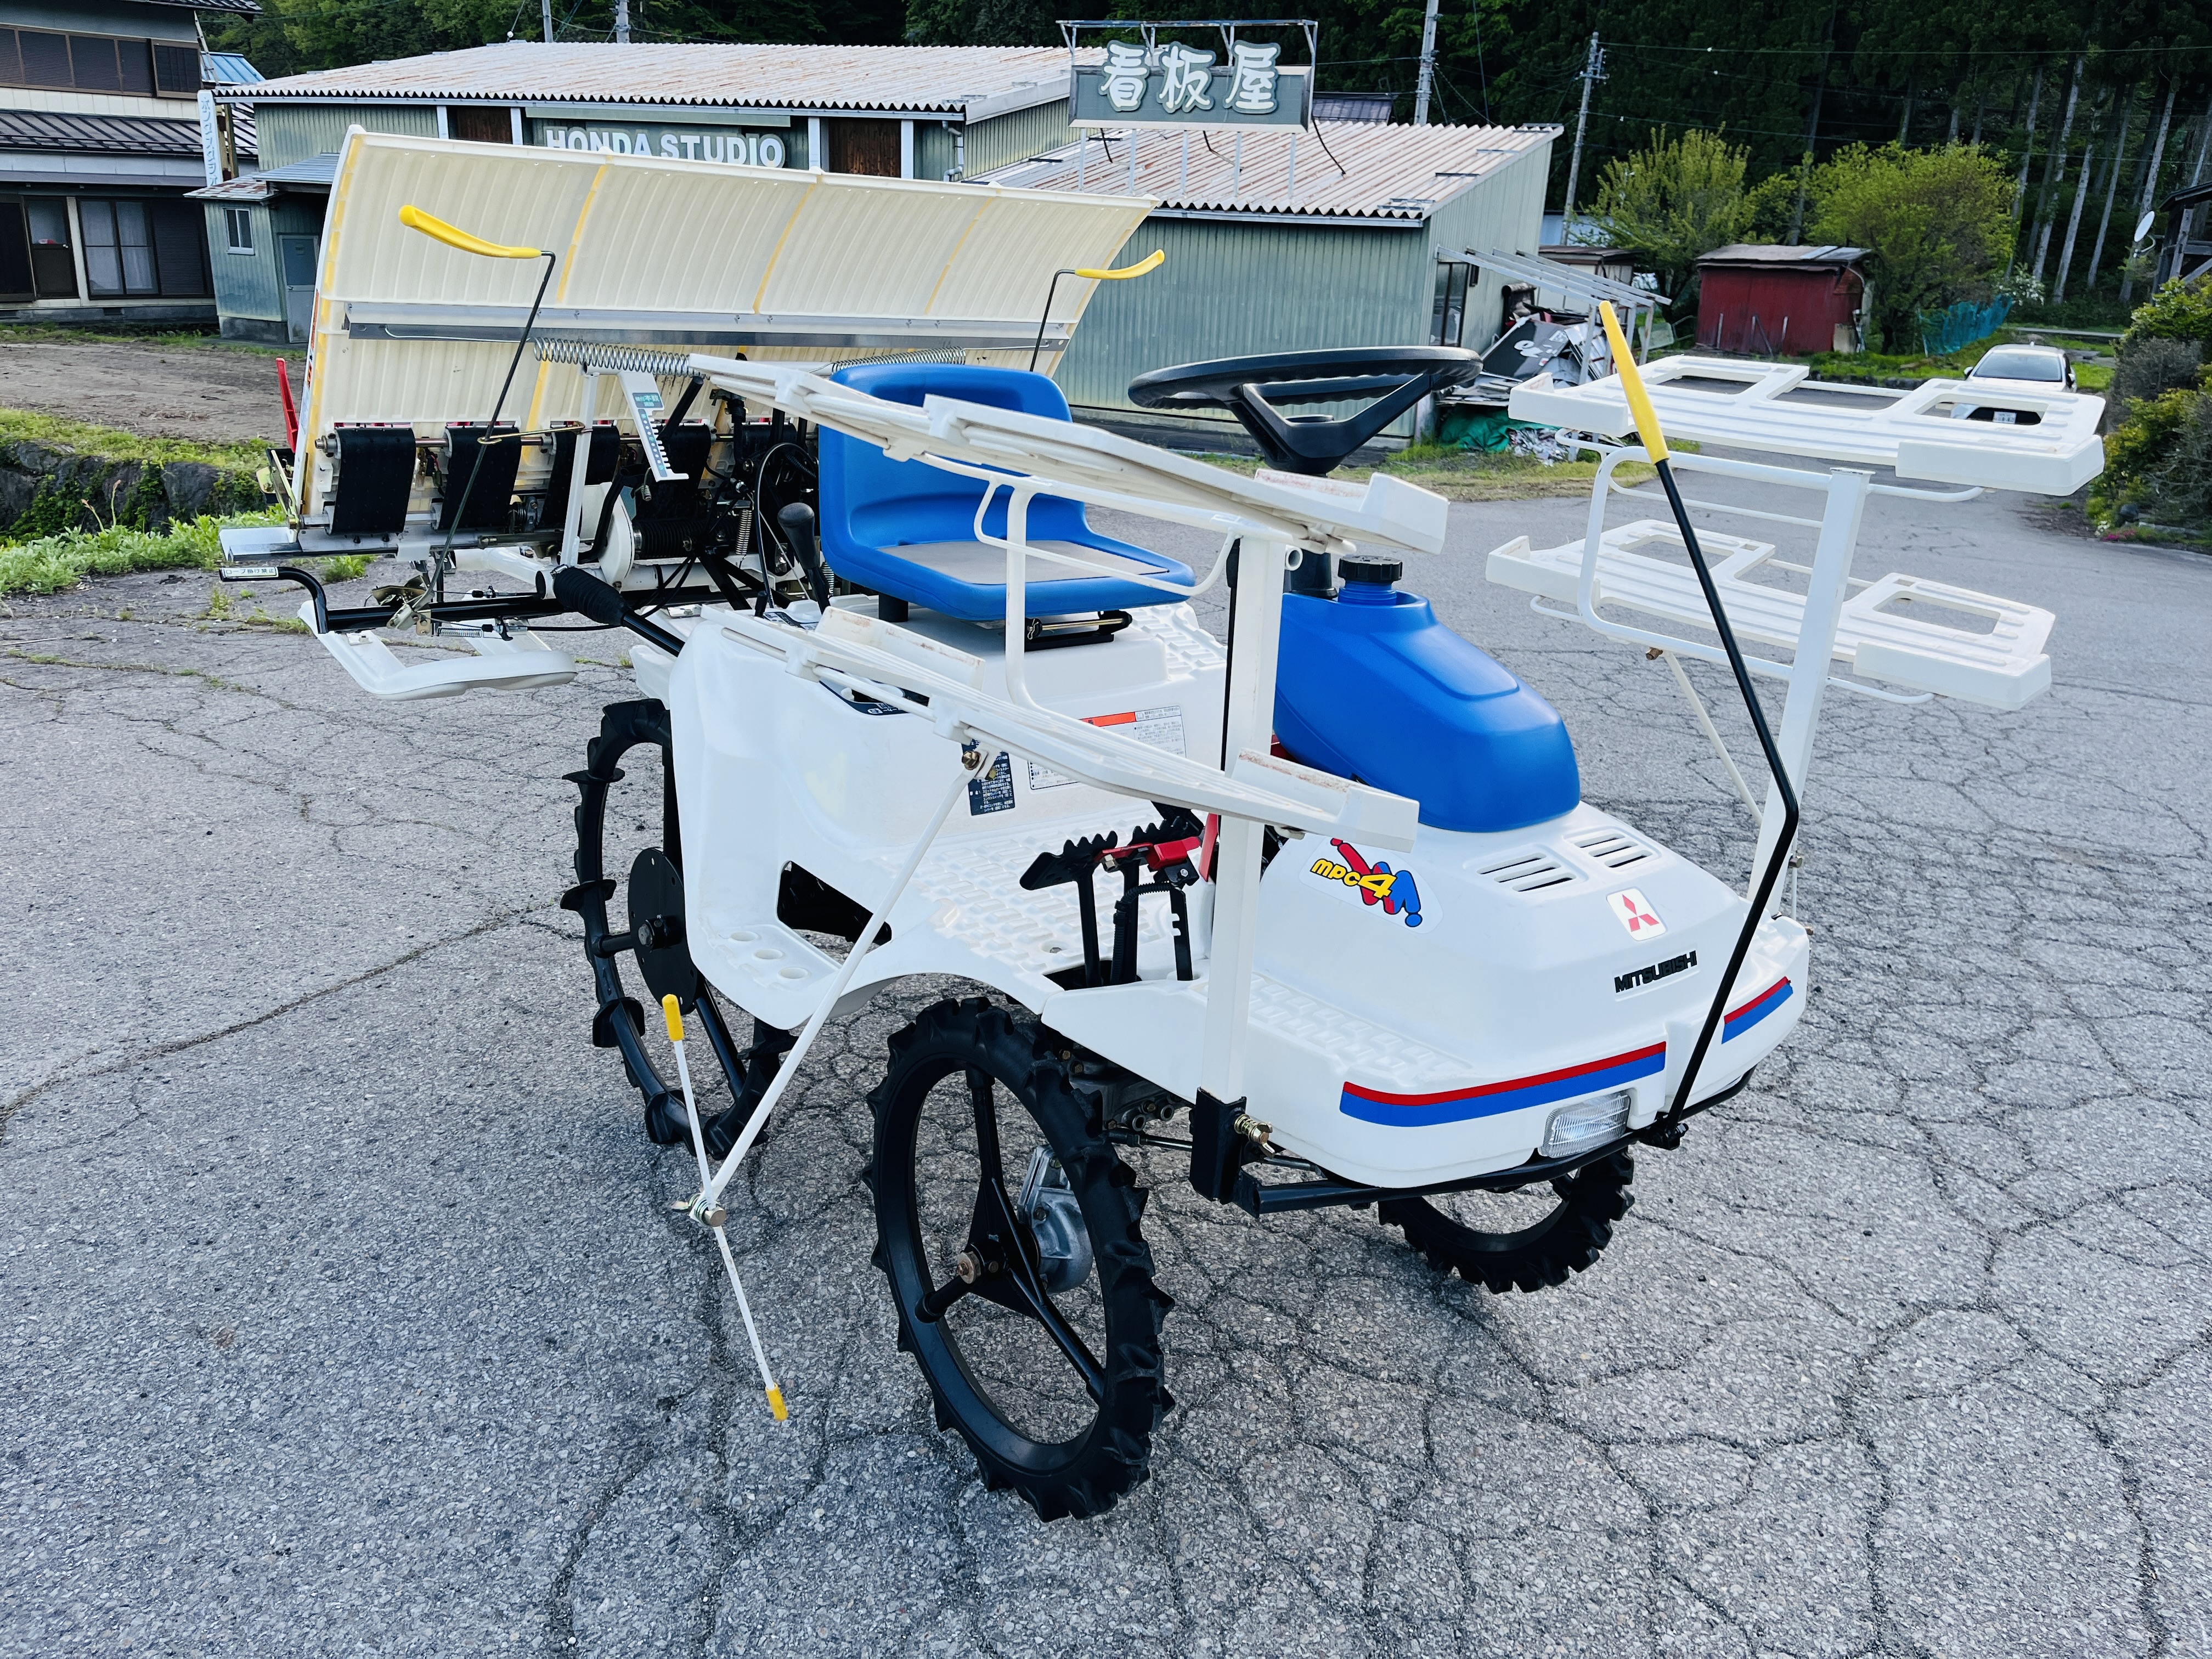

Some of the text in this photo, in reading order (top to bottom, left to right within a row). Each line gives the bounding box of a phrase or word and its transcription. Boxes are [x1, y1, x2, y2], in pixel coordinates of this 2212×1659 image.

[1099, 43, 1279, 111] 看板屋
[546, 129, 783, 167] HONDA STUDIO
[1614, 950, 1697, 993] MITSUBISHI
